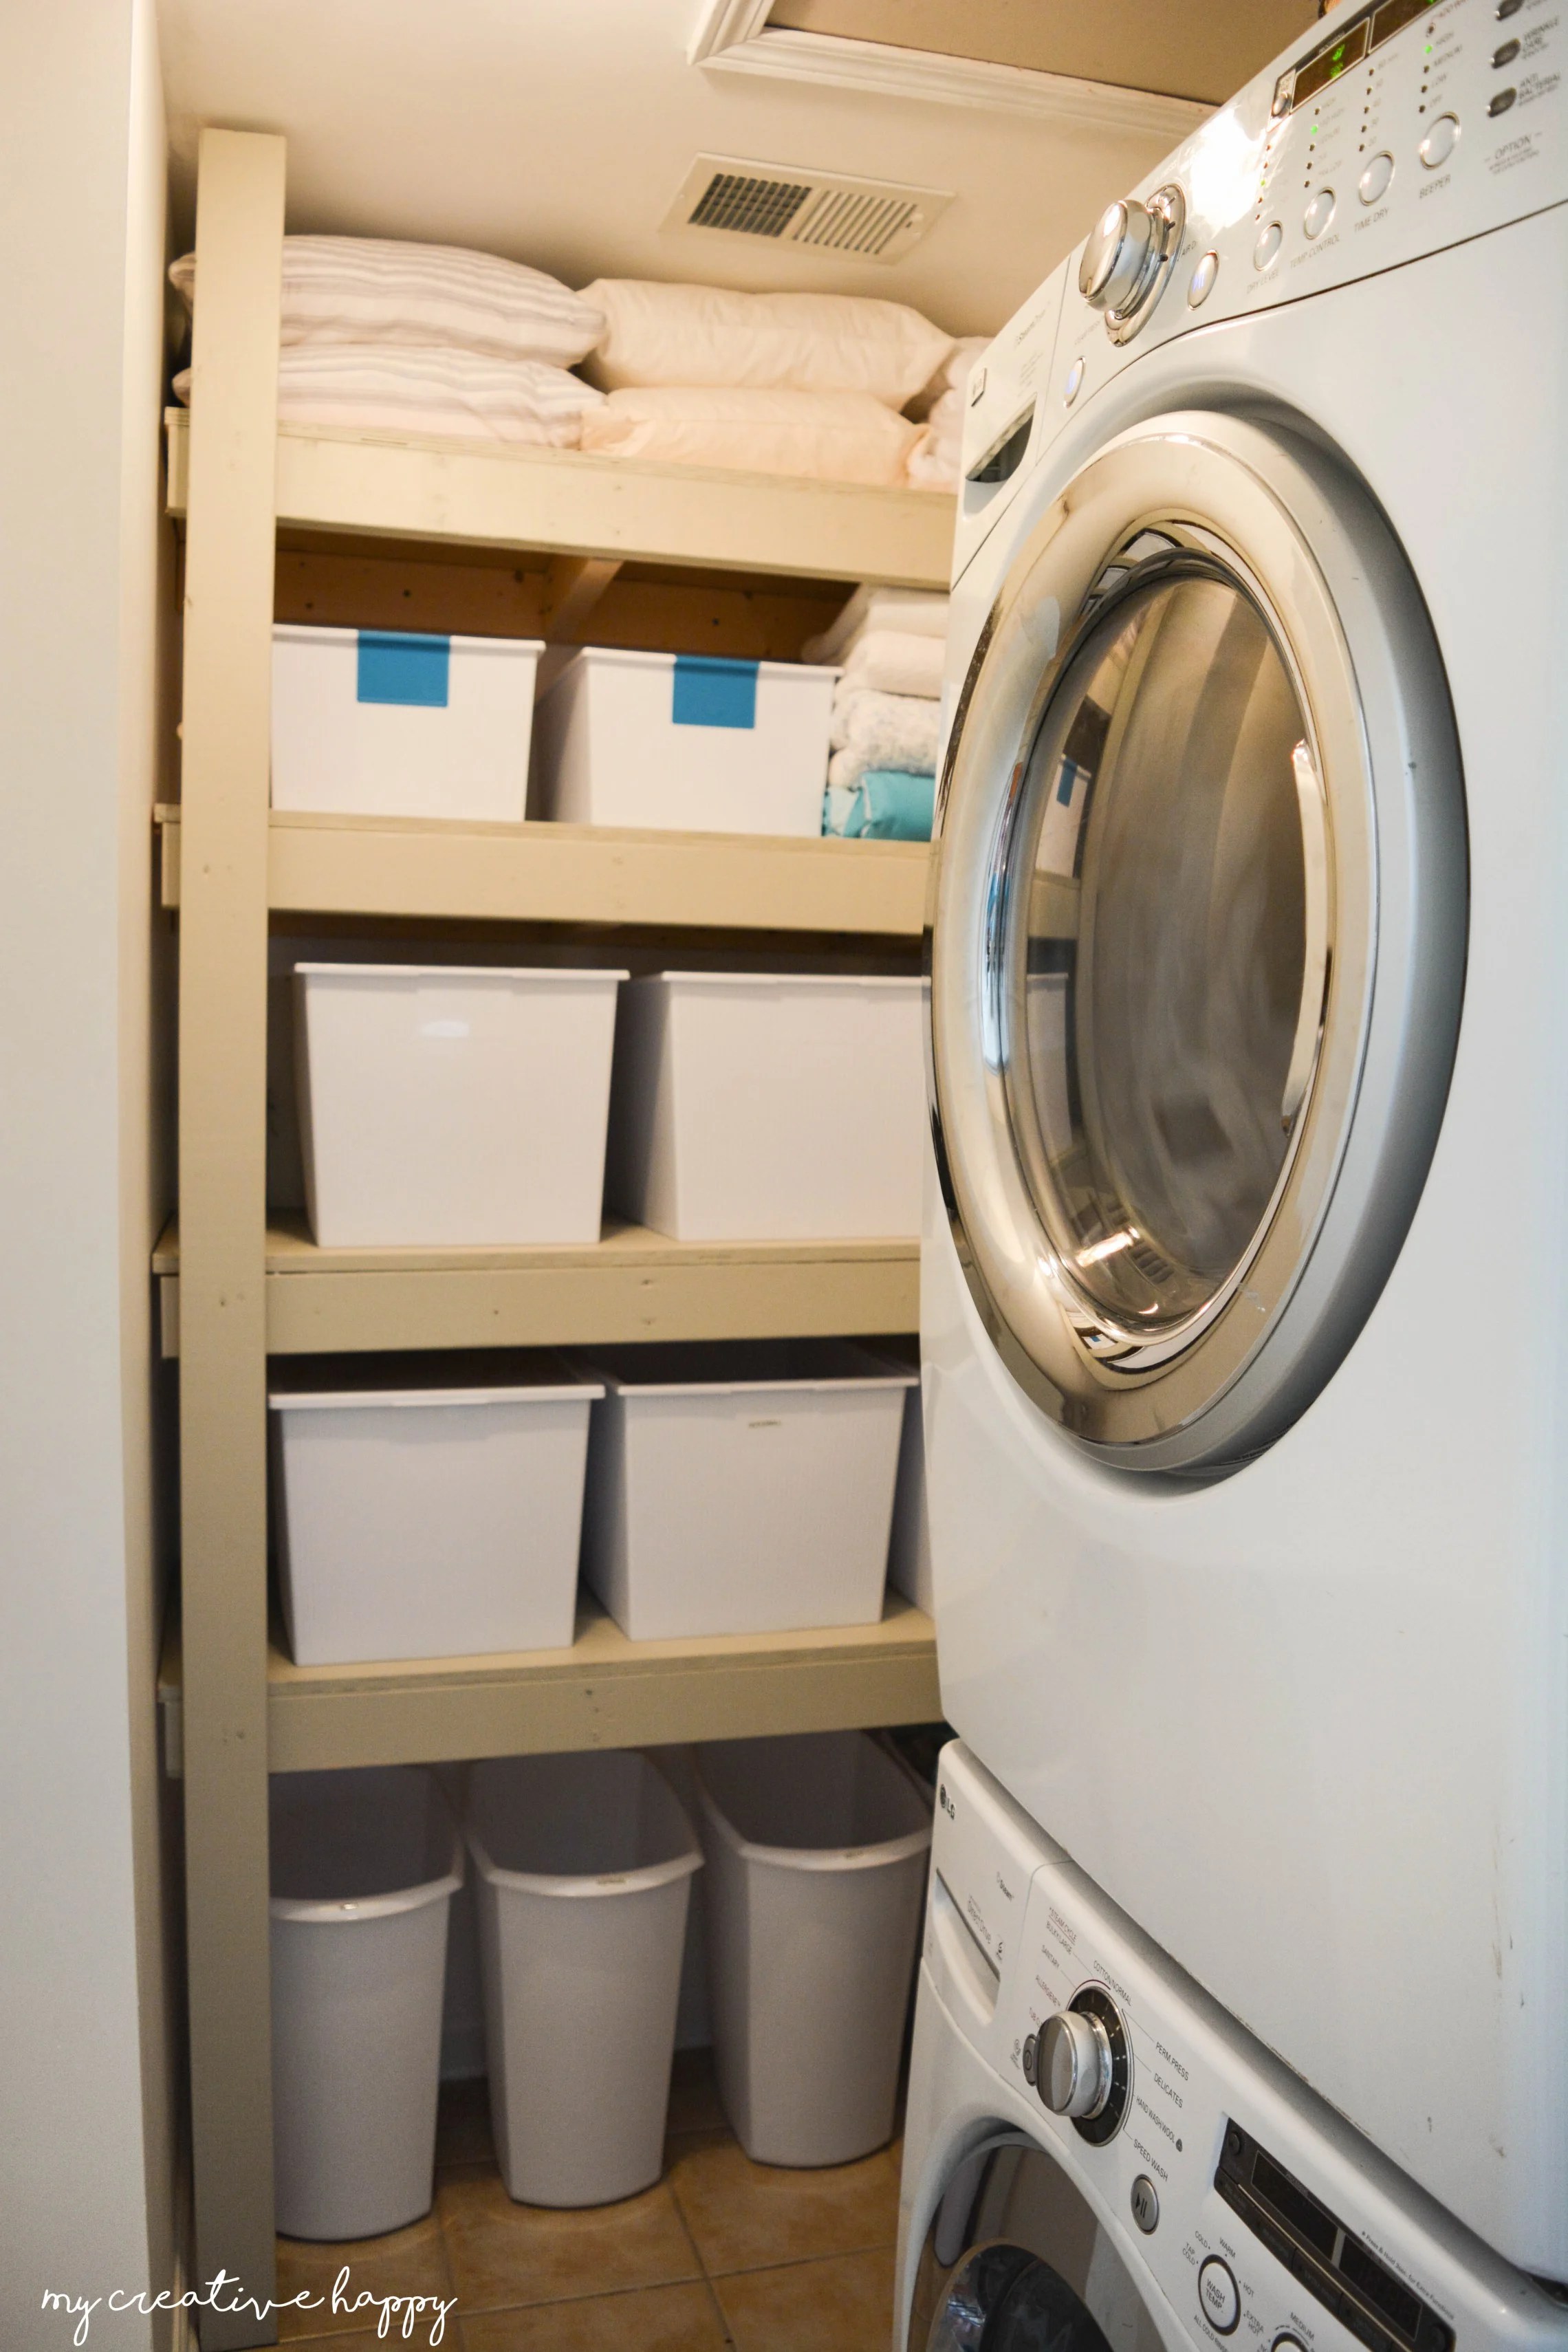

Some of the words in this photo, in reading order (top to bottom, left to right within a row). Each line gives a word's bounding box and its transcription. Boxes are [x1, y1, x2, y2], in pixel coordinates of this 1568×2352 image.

[1419, 174, 1452, 199] BEEPER
[1354, 215, 1373, 233] TIME
[1373, 207, 1389, 224] DRY
[1308, 232, 1340, 258] CONTROL
[1063, 1924, 1077, 1943] CYCLE
[1041, 1945, 1060, 1970] SANITARY
[1093, 1960, 1132, 2006] COTTON/NORMAL
[1154, 2073, 1183, 2109] DELICATES
[1136, 2095, 1148, 2114] HAND
[1133, 2139, 1151, 2163] SPEED
[1151, 2157, 1168, 2182] WASH
[1186, 2242, 1195, 2255] TAP
[1195, 2230, 1208, 2248] COLD
[1219, 2237, 1236, 2259] WARM
[1182, 2248, 1195, 2265] COLD
[1206, 2278, 1226, 2302] WASH
[1243, 2282, 1254, 2298] HOT
[1194, 2315, 1202, 2329] ALL
[1202, 2324, 1215, 2341] COLD
[1245, 2310, 1265, 2334] EXTRA
[1248, 2322, 1260, 2337] HOT
[1290, 2311, 1314, 2340] MEDIUM
